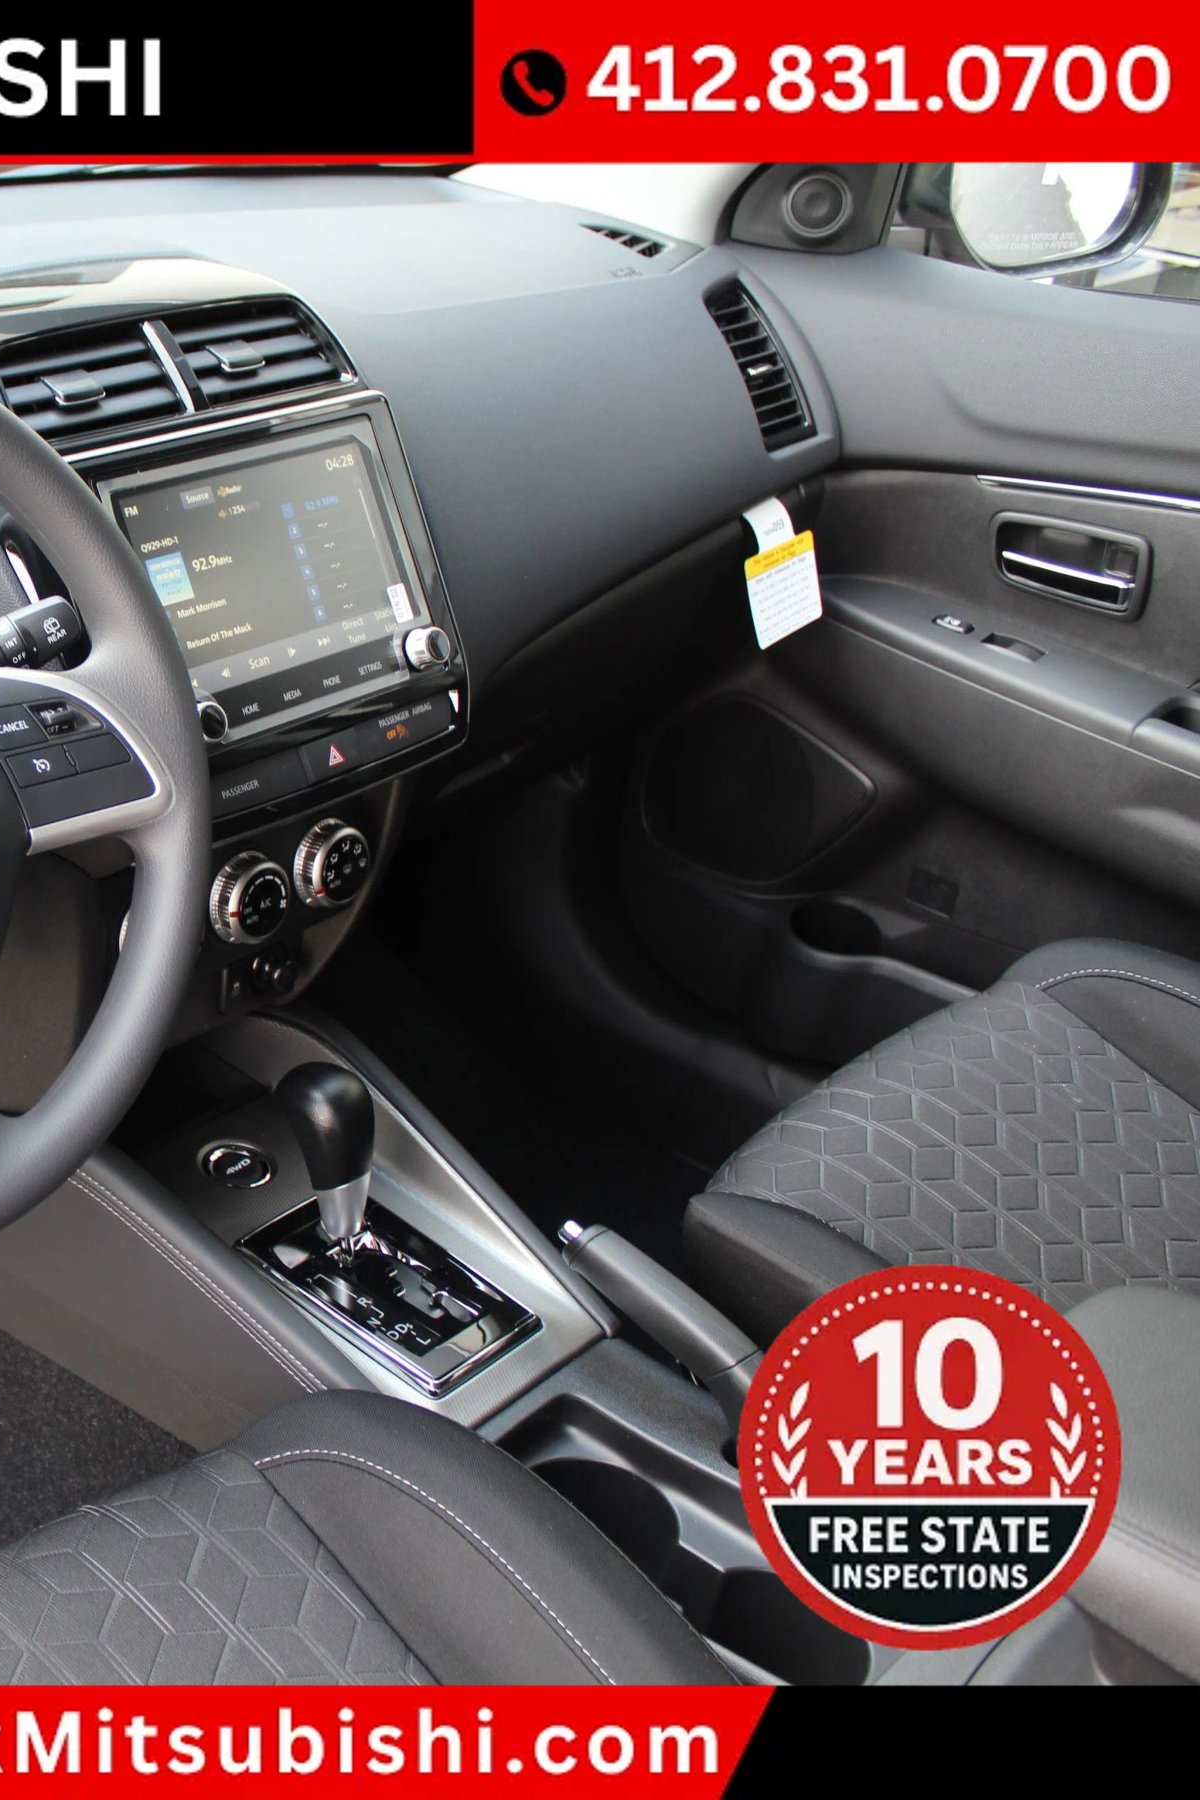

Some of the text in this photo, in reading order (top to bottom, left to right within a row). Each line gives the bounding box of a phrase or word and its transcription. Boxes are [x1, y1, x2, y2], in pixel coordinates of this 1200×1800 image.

[325, 454, 354, 471] 04:28
[185, 492, 209, 505] Source
[123, 505, 139, 518] FM
[140, 536, 179, 554] Q929-HD-1
[177, 598, 227, 619] Mark Morrison
[342, 617, 364, 631] Direct
[46, 628, 67, 645] REAR
[186, 622, 253, 650] Return Of The Mack
[347, 633, 367, 645] Tune
[4, 637, 18, 650] INT
[12, 651, 27, 664] OFF
[248, 656, 270, 671] Scan
[358, 660, 383, 677] SETTINGS
[322, 674, 342, 689] PHONE
[283, 688, 302, 702] MEDIA
[241, 702, 260, 717] HOME
[378, 701, 432, 729] PASSENGER AIRBAG
[221, 779, 259, 800] PASSENGER
[260, 897, 272, 909] A/C
[356, 1296, 374, 1308] R
[386, 1330, 400, 1341] D
[415, 1336, 432, 1346] L
